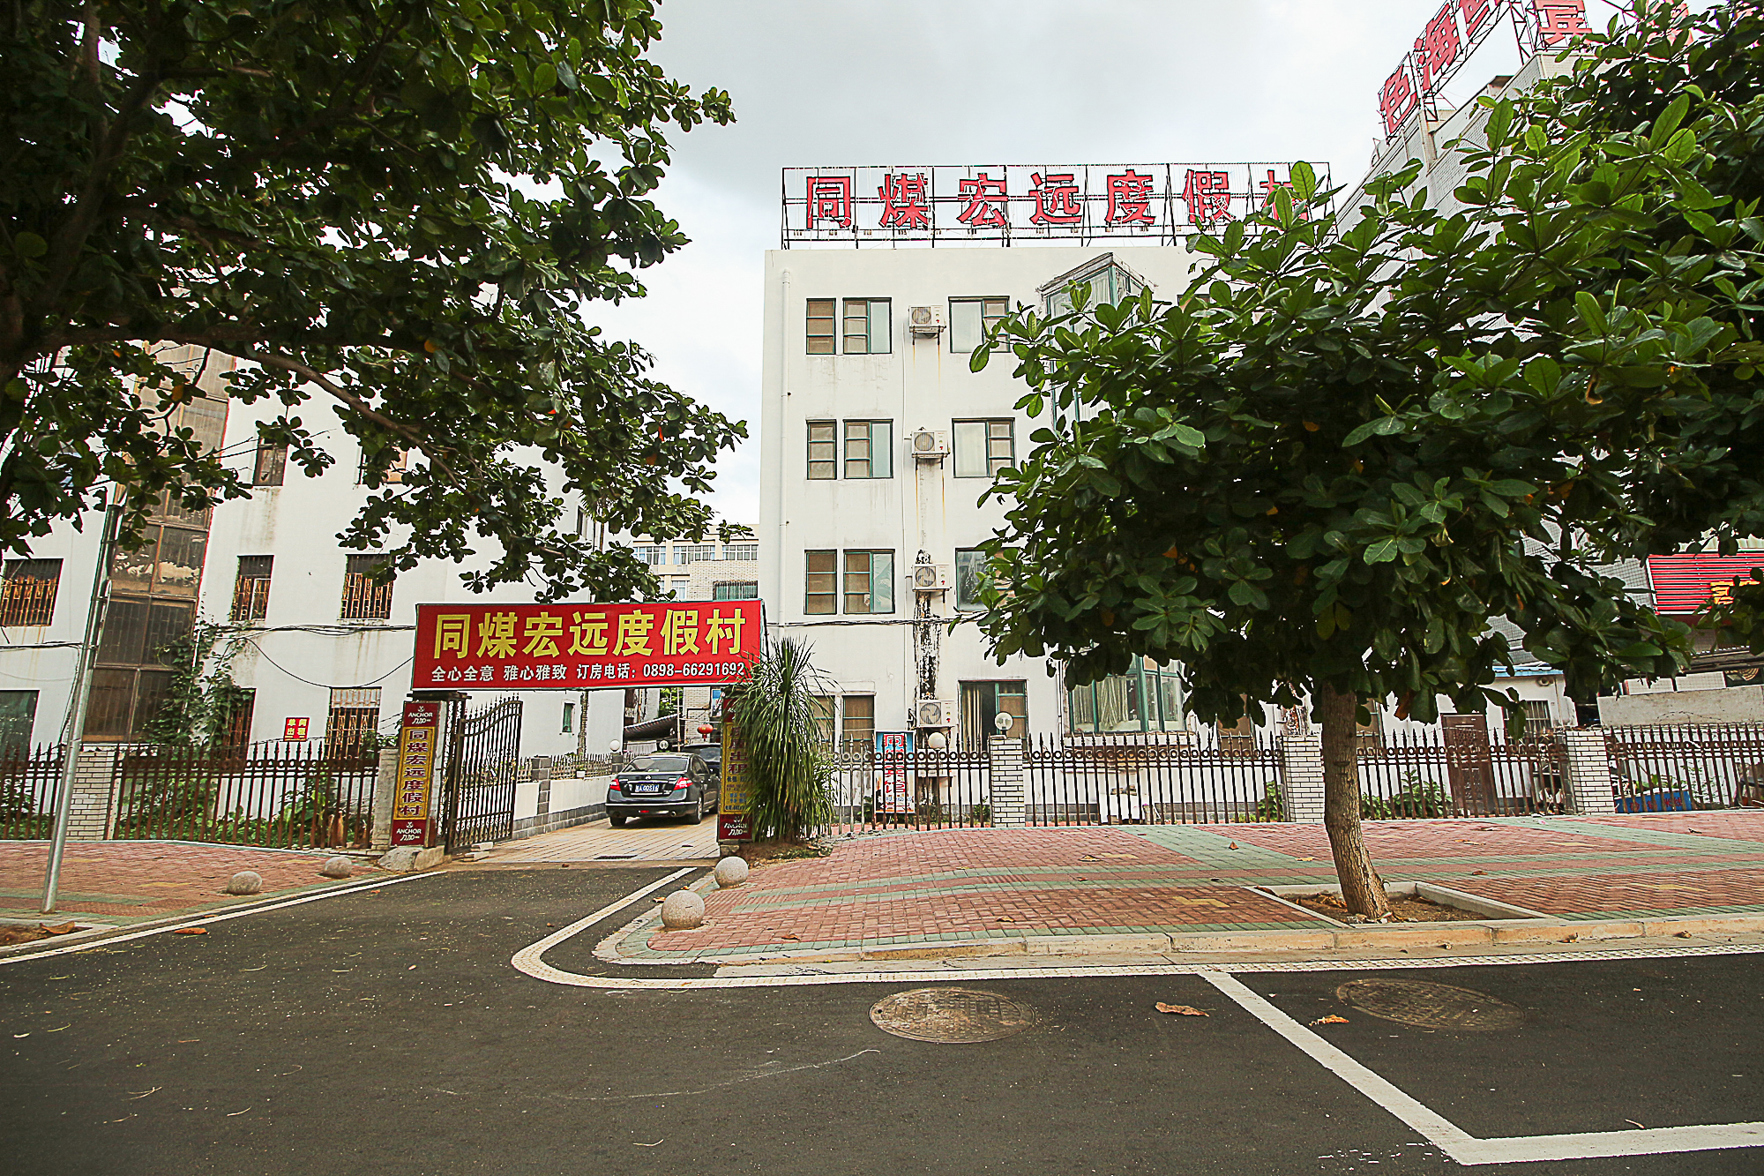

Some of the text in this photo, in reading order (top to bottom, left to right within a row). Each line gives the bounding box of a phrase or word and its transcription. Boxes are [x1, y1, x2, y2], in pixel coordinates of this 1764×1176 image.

[433, 609, 746, 659] 同煤宏远度假村
[431, 665, 495, 682] 全心全意
[503, 664, 567, 681] 雅心雅致
[400, 729, 429, 817] 同煤宏远度假村
